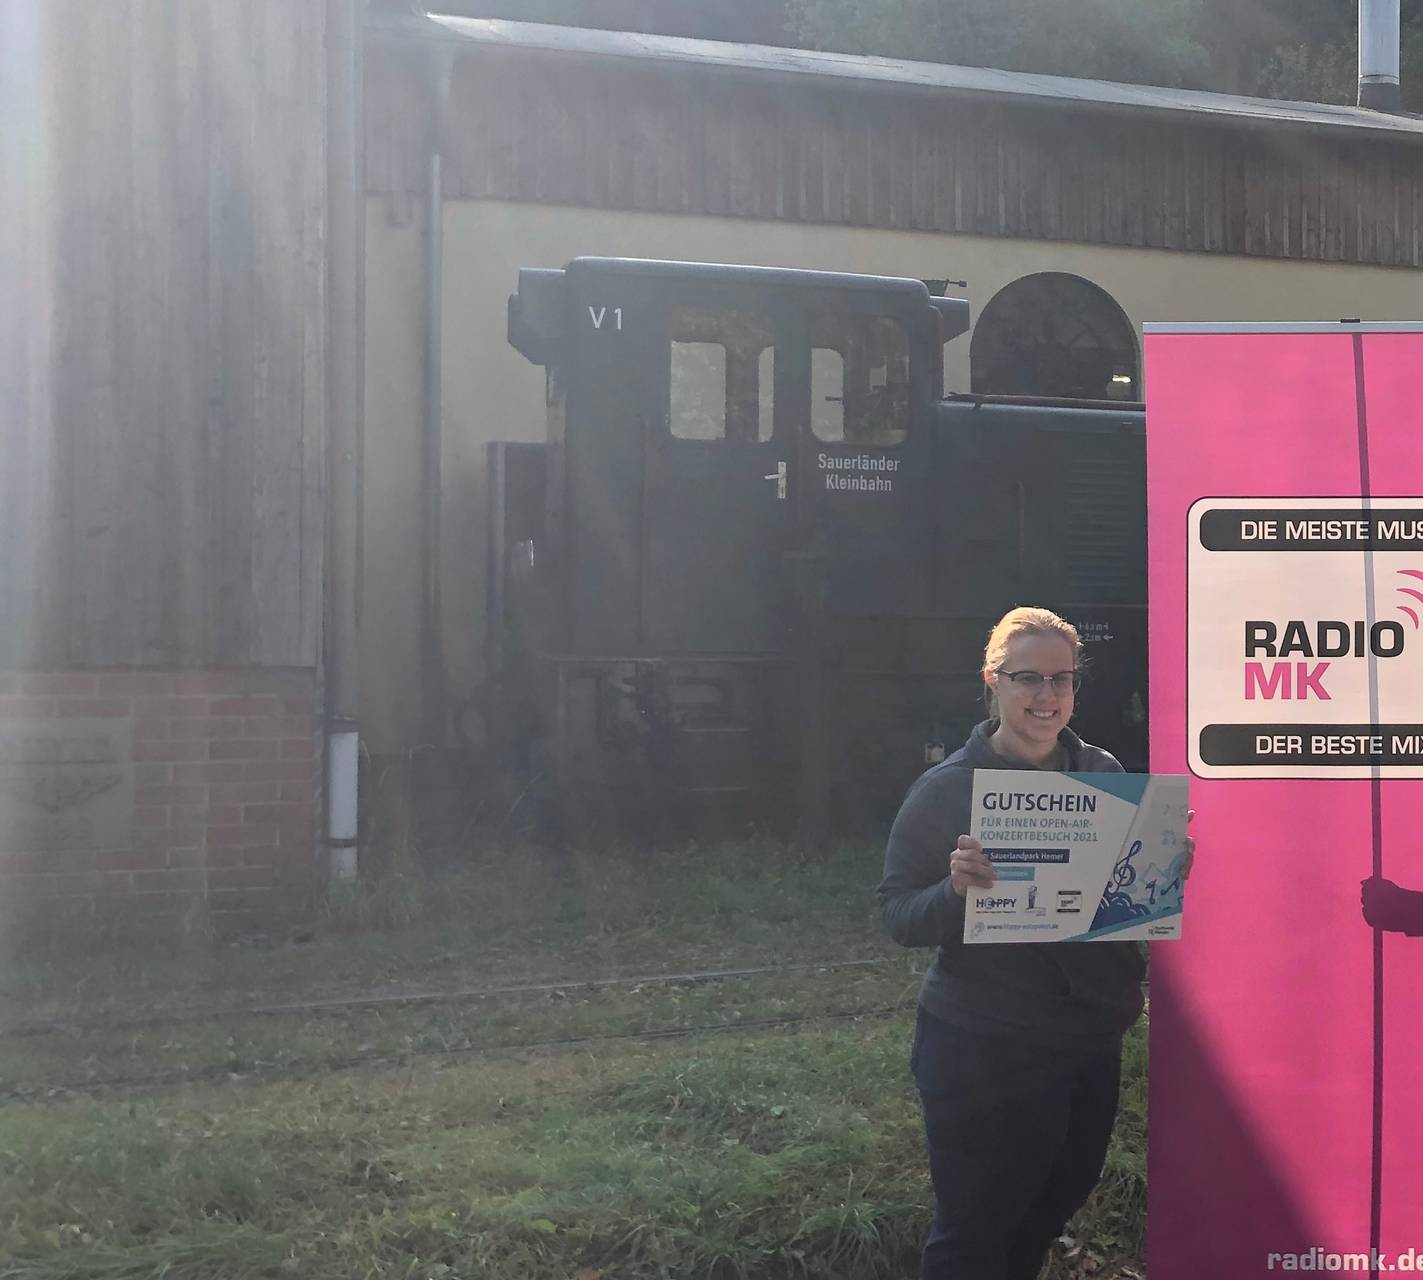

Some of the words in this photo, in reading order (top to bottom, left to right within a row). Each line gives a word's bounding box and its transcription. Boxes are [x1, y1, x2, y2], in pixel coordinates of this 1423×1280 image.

[588, 306, 606, 329] V
[614, 308, 622, 330] 1
[818, 453, 900, 471] Sauerländer
[826, 473, 892, 491] Kleinbahn
[1240, 520, 1278, 540] DIE
[1285, 520, 1370, 540] MEISTE
[1244, 620, 1405, 658] RADIO
[1244, 662, 1332, 700] MK
[1255, 735, 1303, 755] DER
[1311, 735, 1383, 755] BESTE
[982, 792, 1097, 812] GUTSCHEIN
[980, 816, 1002, 828] FÜR
[1005, 818, 1037, 828] EINEN
[1039, 818, 1093, 829] OPEN-AIR-
[980, 831, 1071, 841] KONZERTBESUCH
[1072, 832, 1098, 842] 2021
[990, 852, 1040, 861] Sauerlandpark
[1041, 852, 1065, 861] Hemer
